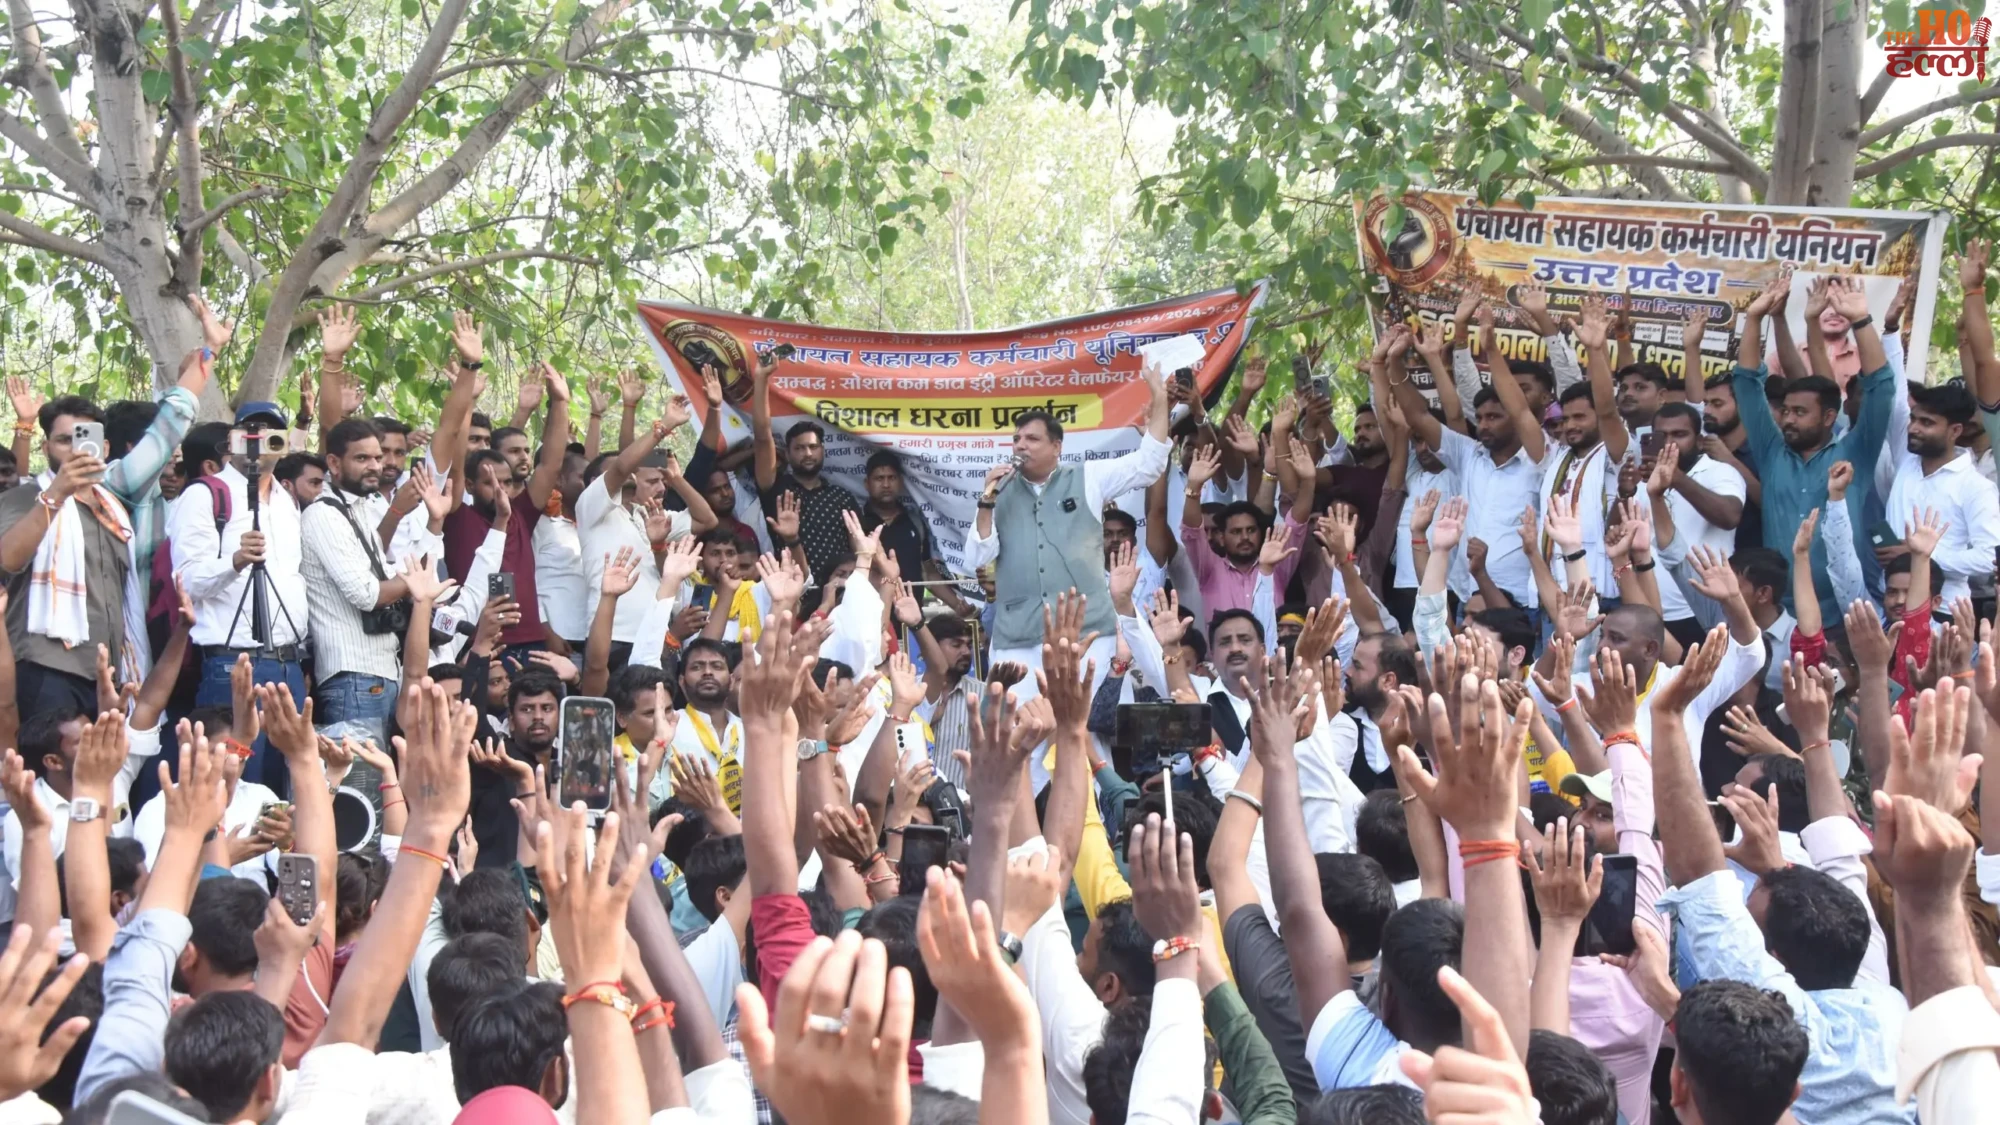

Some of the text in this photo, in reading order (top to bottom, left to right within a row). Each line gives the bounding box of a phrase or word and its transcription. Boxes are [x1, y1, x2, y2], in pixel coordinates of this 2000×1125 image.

[1456, 197, 1883, 271] पंचायत सहायक कर्मचारी यूनियन
[1533, 258, 1721, 295] उत्तर प्रदेश
[859, 350, 962, 369] सहायक
[968, 338, 1079, 368] कर्मचारी
[773, 375, 827, 391] सम्बद्ध
[840, 371, 893, 391] सोशल
[896, 377, 930, 390] कम
[1000, 369, 1065, 391] ऑपरेटर
[1068, 368, 1136, 388] वेलफेयर
[816, 401, 900, 428] विशाल
[909, 406, 982, 429] धरना
[898, 438, 932, 449] हमारी
[936, 439, 967, 450] प्रमुख
[956, 455, 994, 465] समकक्ष
[1084, 449, 1110, 461] किया
[934, 469, 963, 479] बराबर
